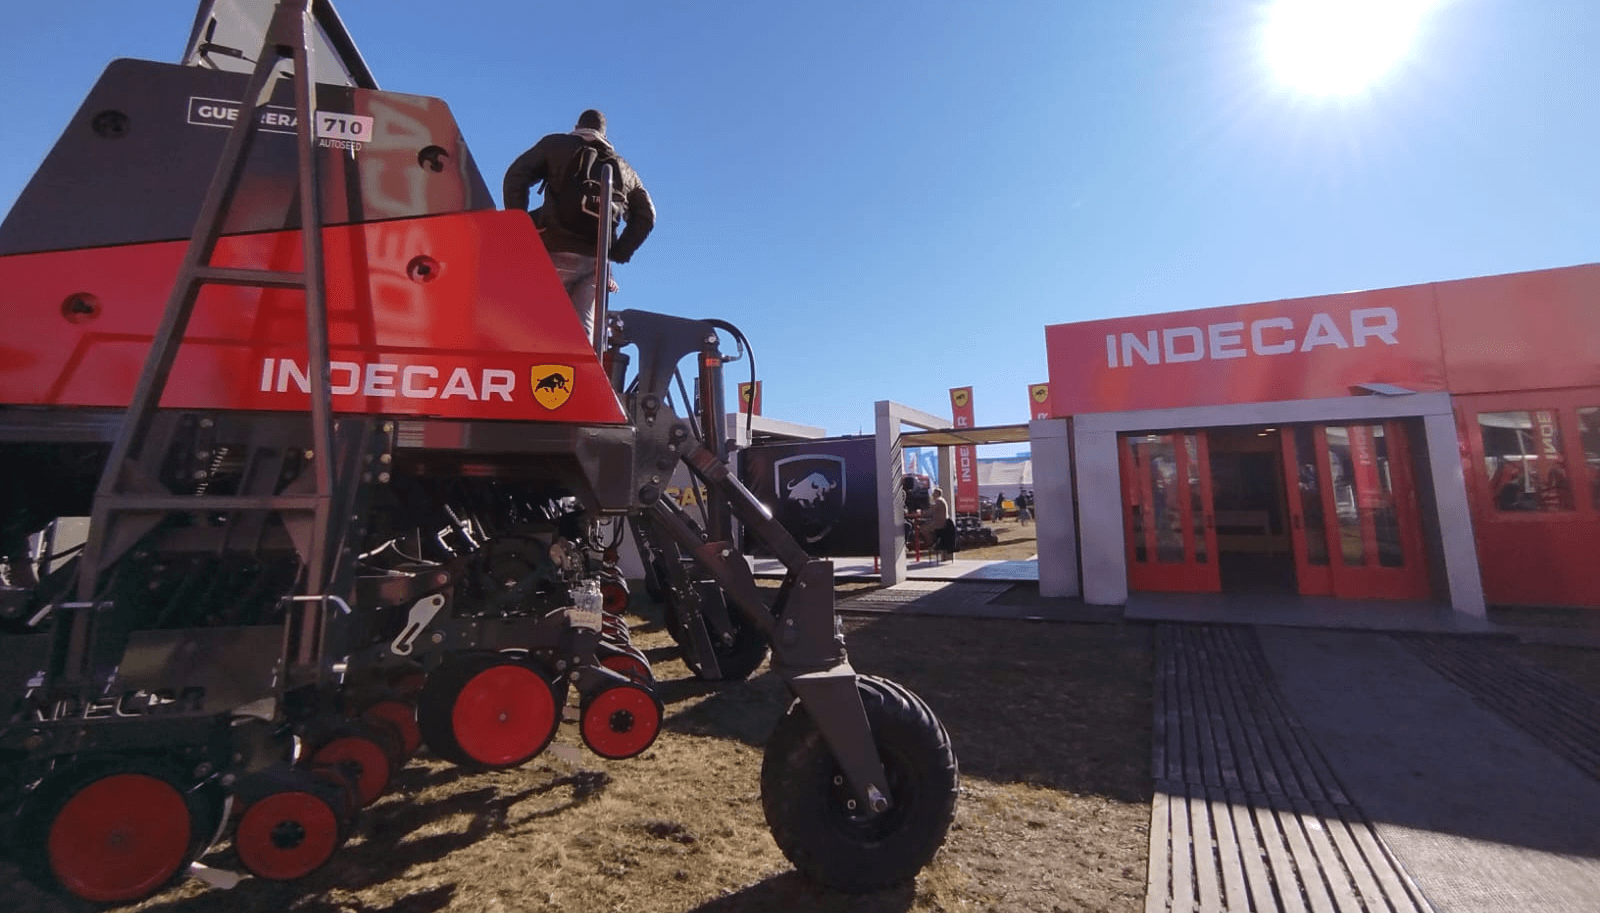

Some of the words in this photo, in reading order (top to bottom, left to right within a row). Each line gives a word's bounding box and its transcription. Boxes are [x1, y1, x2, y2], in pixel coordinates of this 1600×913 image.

[198, 104, 299, 127] GUEER
[323, 117, 363, 135] 710
[318, 138, 362, 151] AUTOSEED
[1106, 307, 1399, 369] INDECAR
[259, 358, 516, 402] INDECAR
[957, 415, 972, 482] INDER
